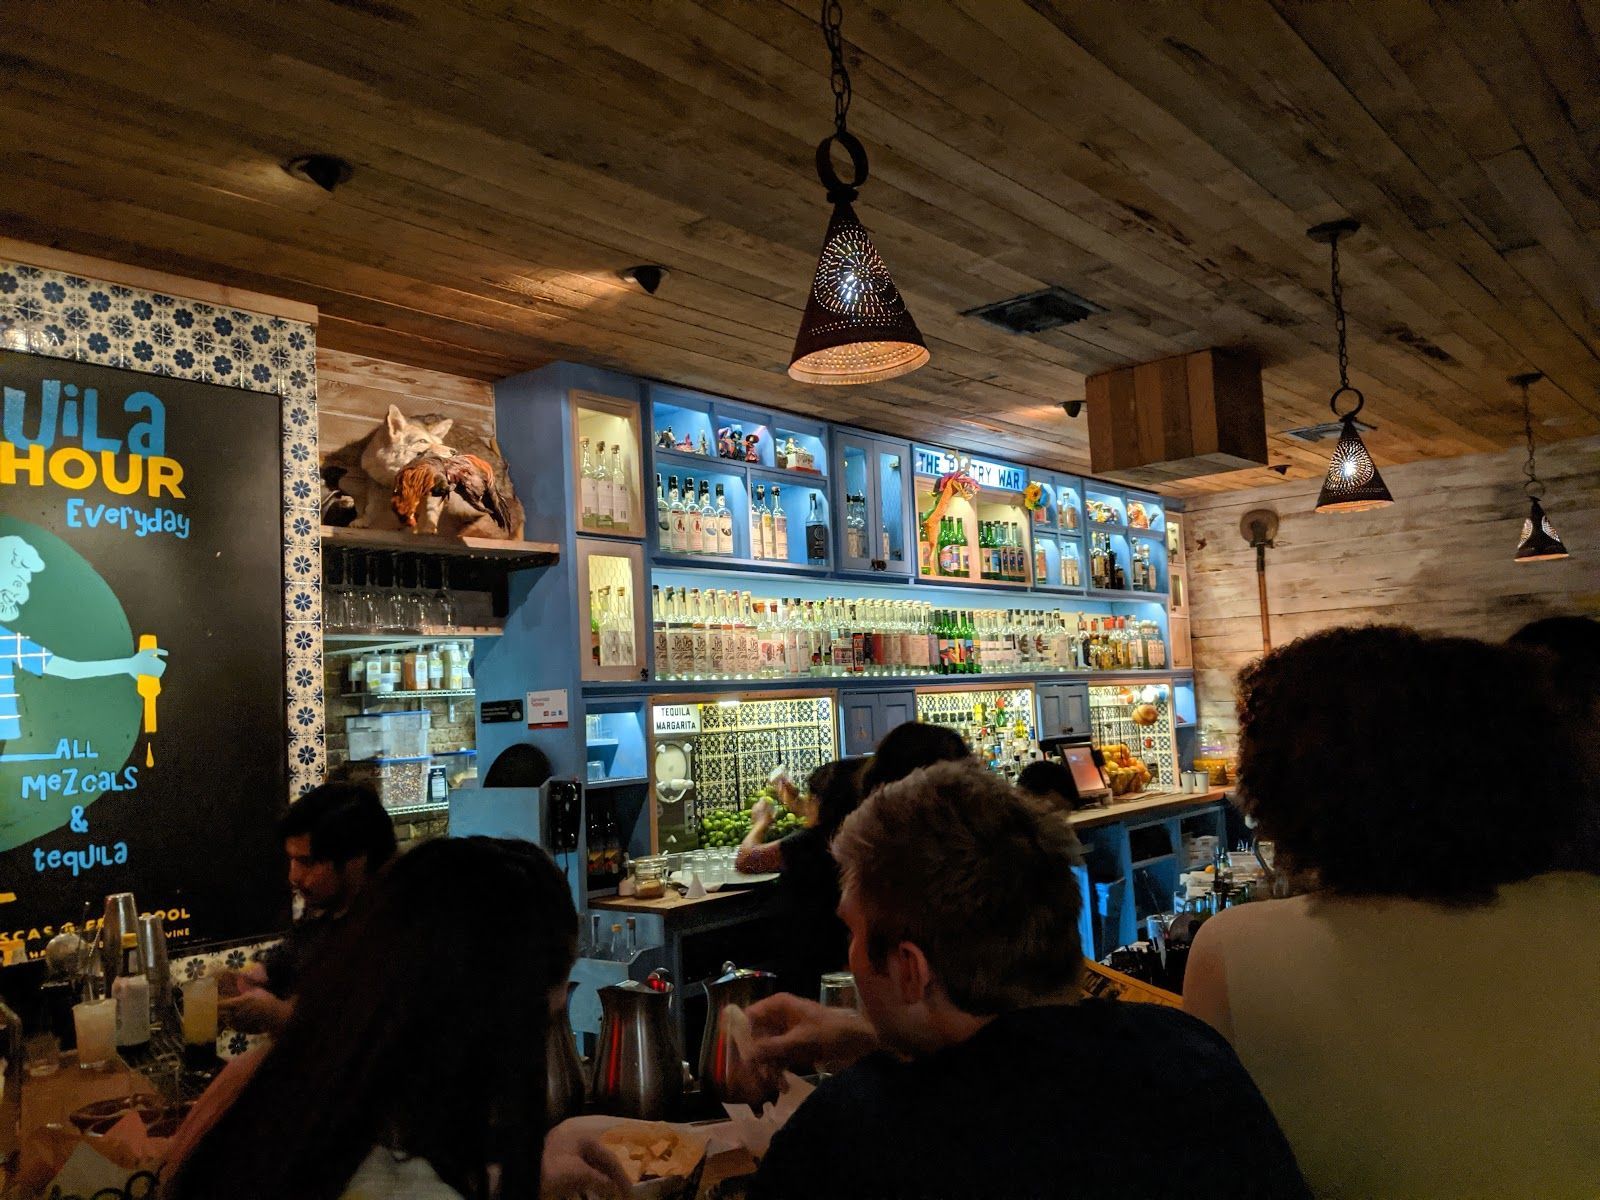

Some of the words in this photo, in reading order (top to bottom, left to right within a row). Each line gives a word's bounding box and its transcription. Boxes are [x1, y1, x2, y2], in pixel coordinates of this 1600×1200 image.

[0, 441, 186, 499] HOUR
[919, 452, 941, 474] THE
[998, 469, 1020, 489] WAR
[66, 498, 190, 539] Everyday
[656, 720, 697, 731] MARGARITA
[661, 707, 691, 717] TEQUILA
[55, 738, 98, 759] ALL
[69, 805, 89, 833] &
